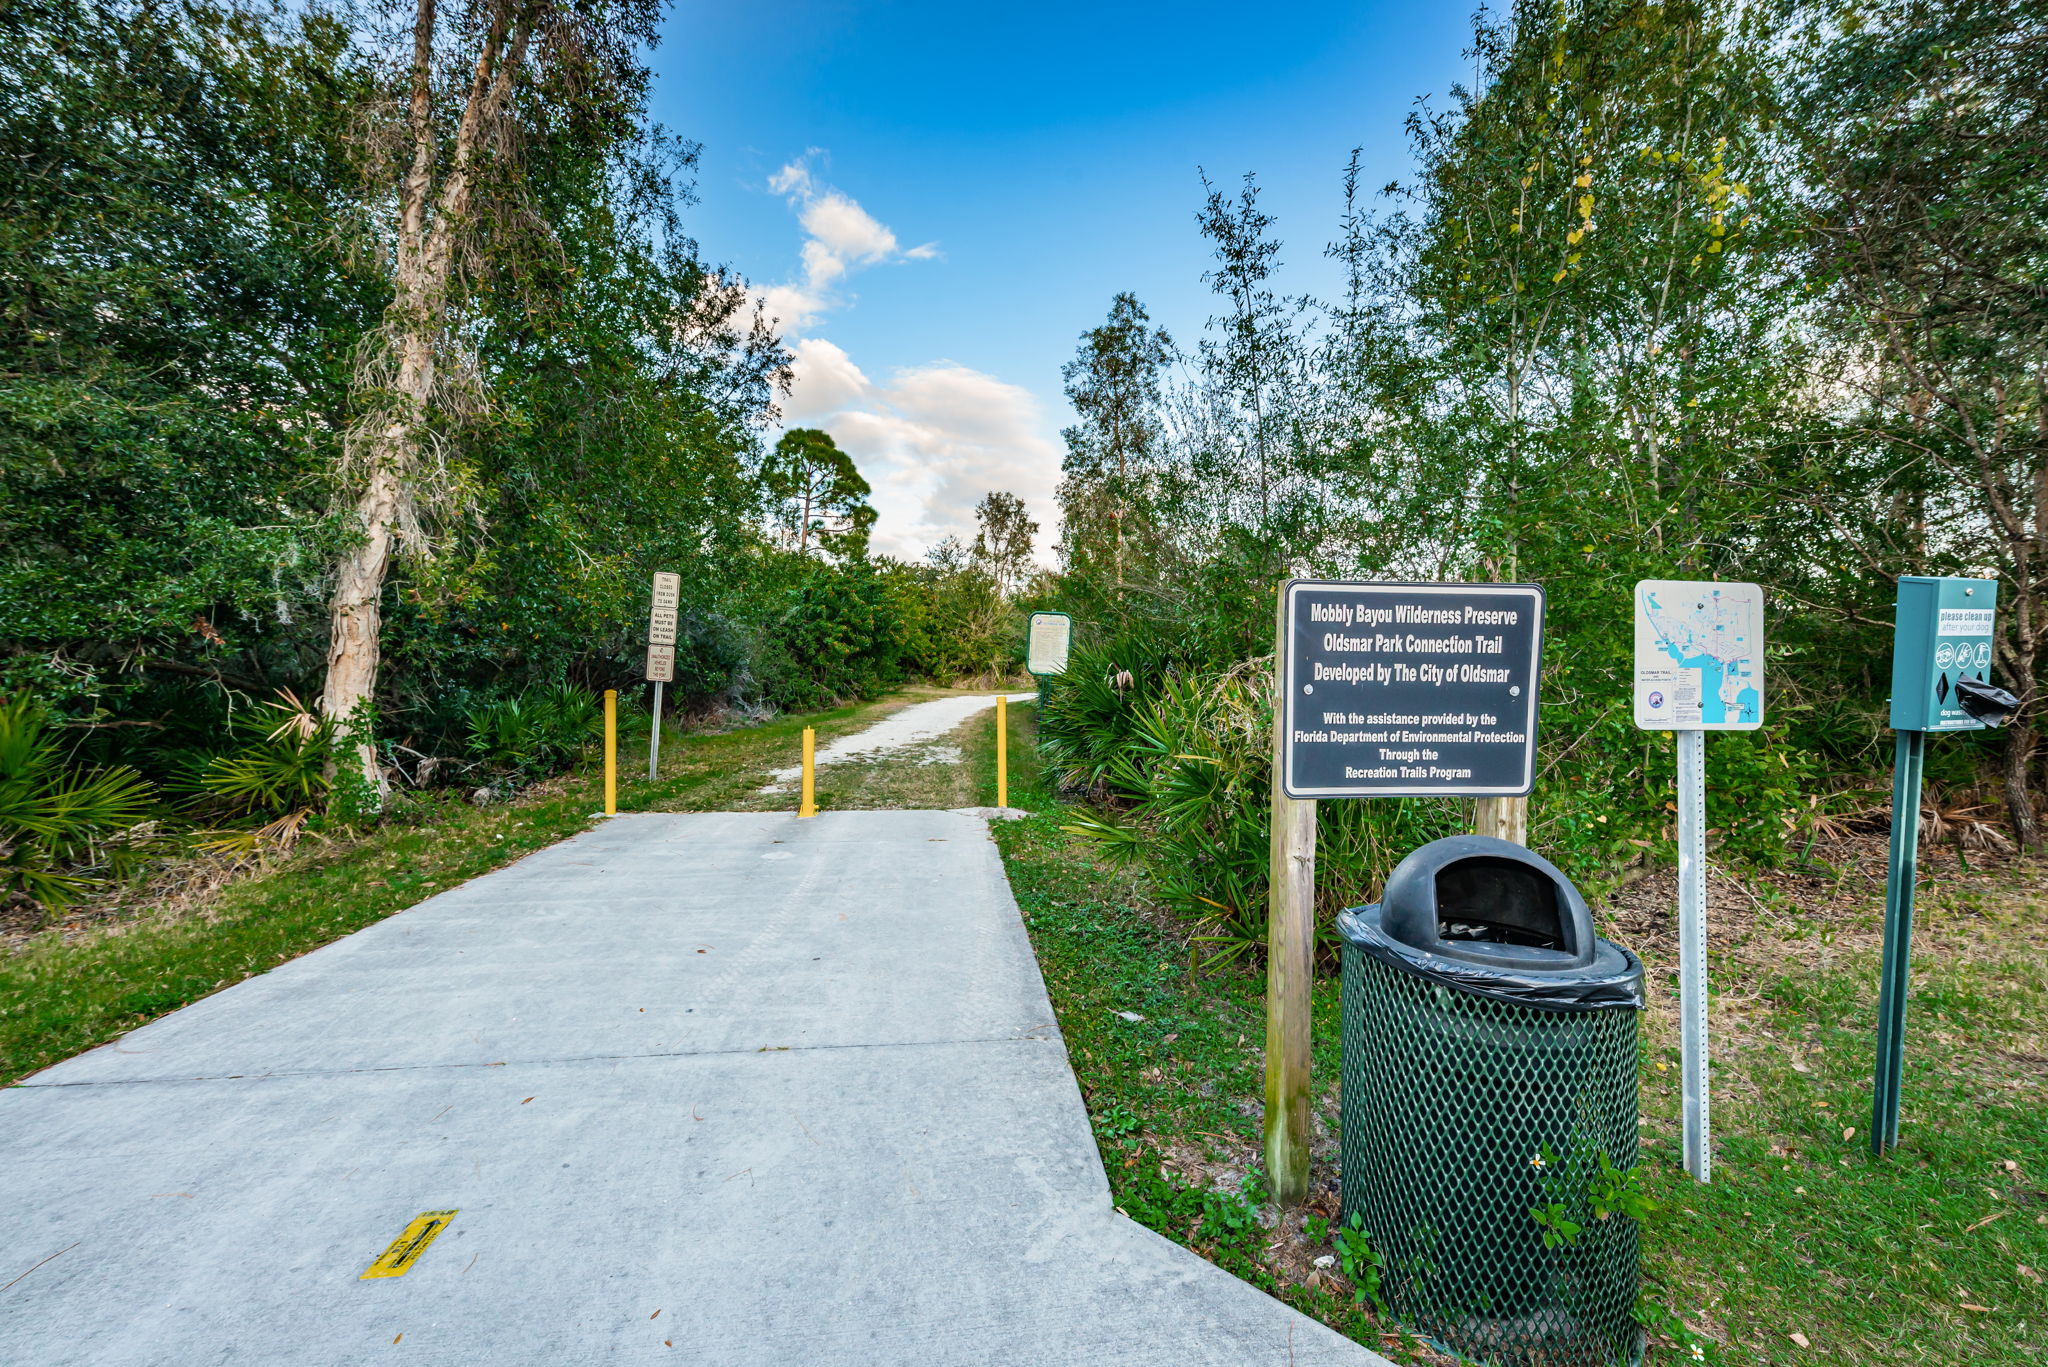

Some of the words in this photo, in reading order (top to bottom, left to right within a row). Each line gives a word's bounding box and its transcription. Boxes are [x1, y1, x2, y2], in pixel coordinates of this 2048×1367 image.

[1311, 604, 1353, 626] Mobbly
[1356, 604, 1392, 627] Bayou
[1396, 605, 1461, 624] Wilderness
[1464, 606, 1517, 625] Preserve
[1941, 612, 1963, 621] please
[1965, 612, 1982, 621] clean
[1976, 623, 1989, 633] dog
[1324, 633, 1372, 652] Oldsmar
[1376, 634, 1402, 652] Park
[1406, 635, 1472, 653] Connection
[1476, 636, 1502, 653] Trail
[1314, 663, 1374, 685] Developed
[1377, 663, 1390, 685] by
[1394, 664, 1416, 682] The
[1420, 665, 1444, 686] City
[1446, 665, 1458, 682] of
[1461, 664, 1510, 683] Oldsmar
[1324, 712, 1345, 724] With
[1348, 713, 1364, 724] the
[1367, 713, 1419, 724] assistance
[1422, 713, 1464, 726] provided
[1466, 714, 1478, 726] by
[1481, 714, 1496, 725] the
[1940, 709, 1950, 717] dog
[1294, 731, 1328, 742] Florida
[1330, 731, 1387, 744] Department
[1390, 731, 1400, 742] of
[1402, 731, 1471, 742] Environmental
[1474, 732, 1525, 743] Protection
[1380, 749, 1419, 761] Through
[1422, 749, 1438, 760] the
[1345, 767, 1397, 778] Recreation
[1400, 767, 1426, 778] Trails
[1430, 767, 1471, 780] Program
